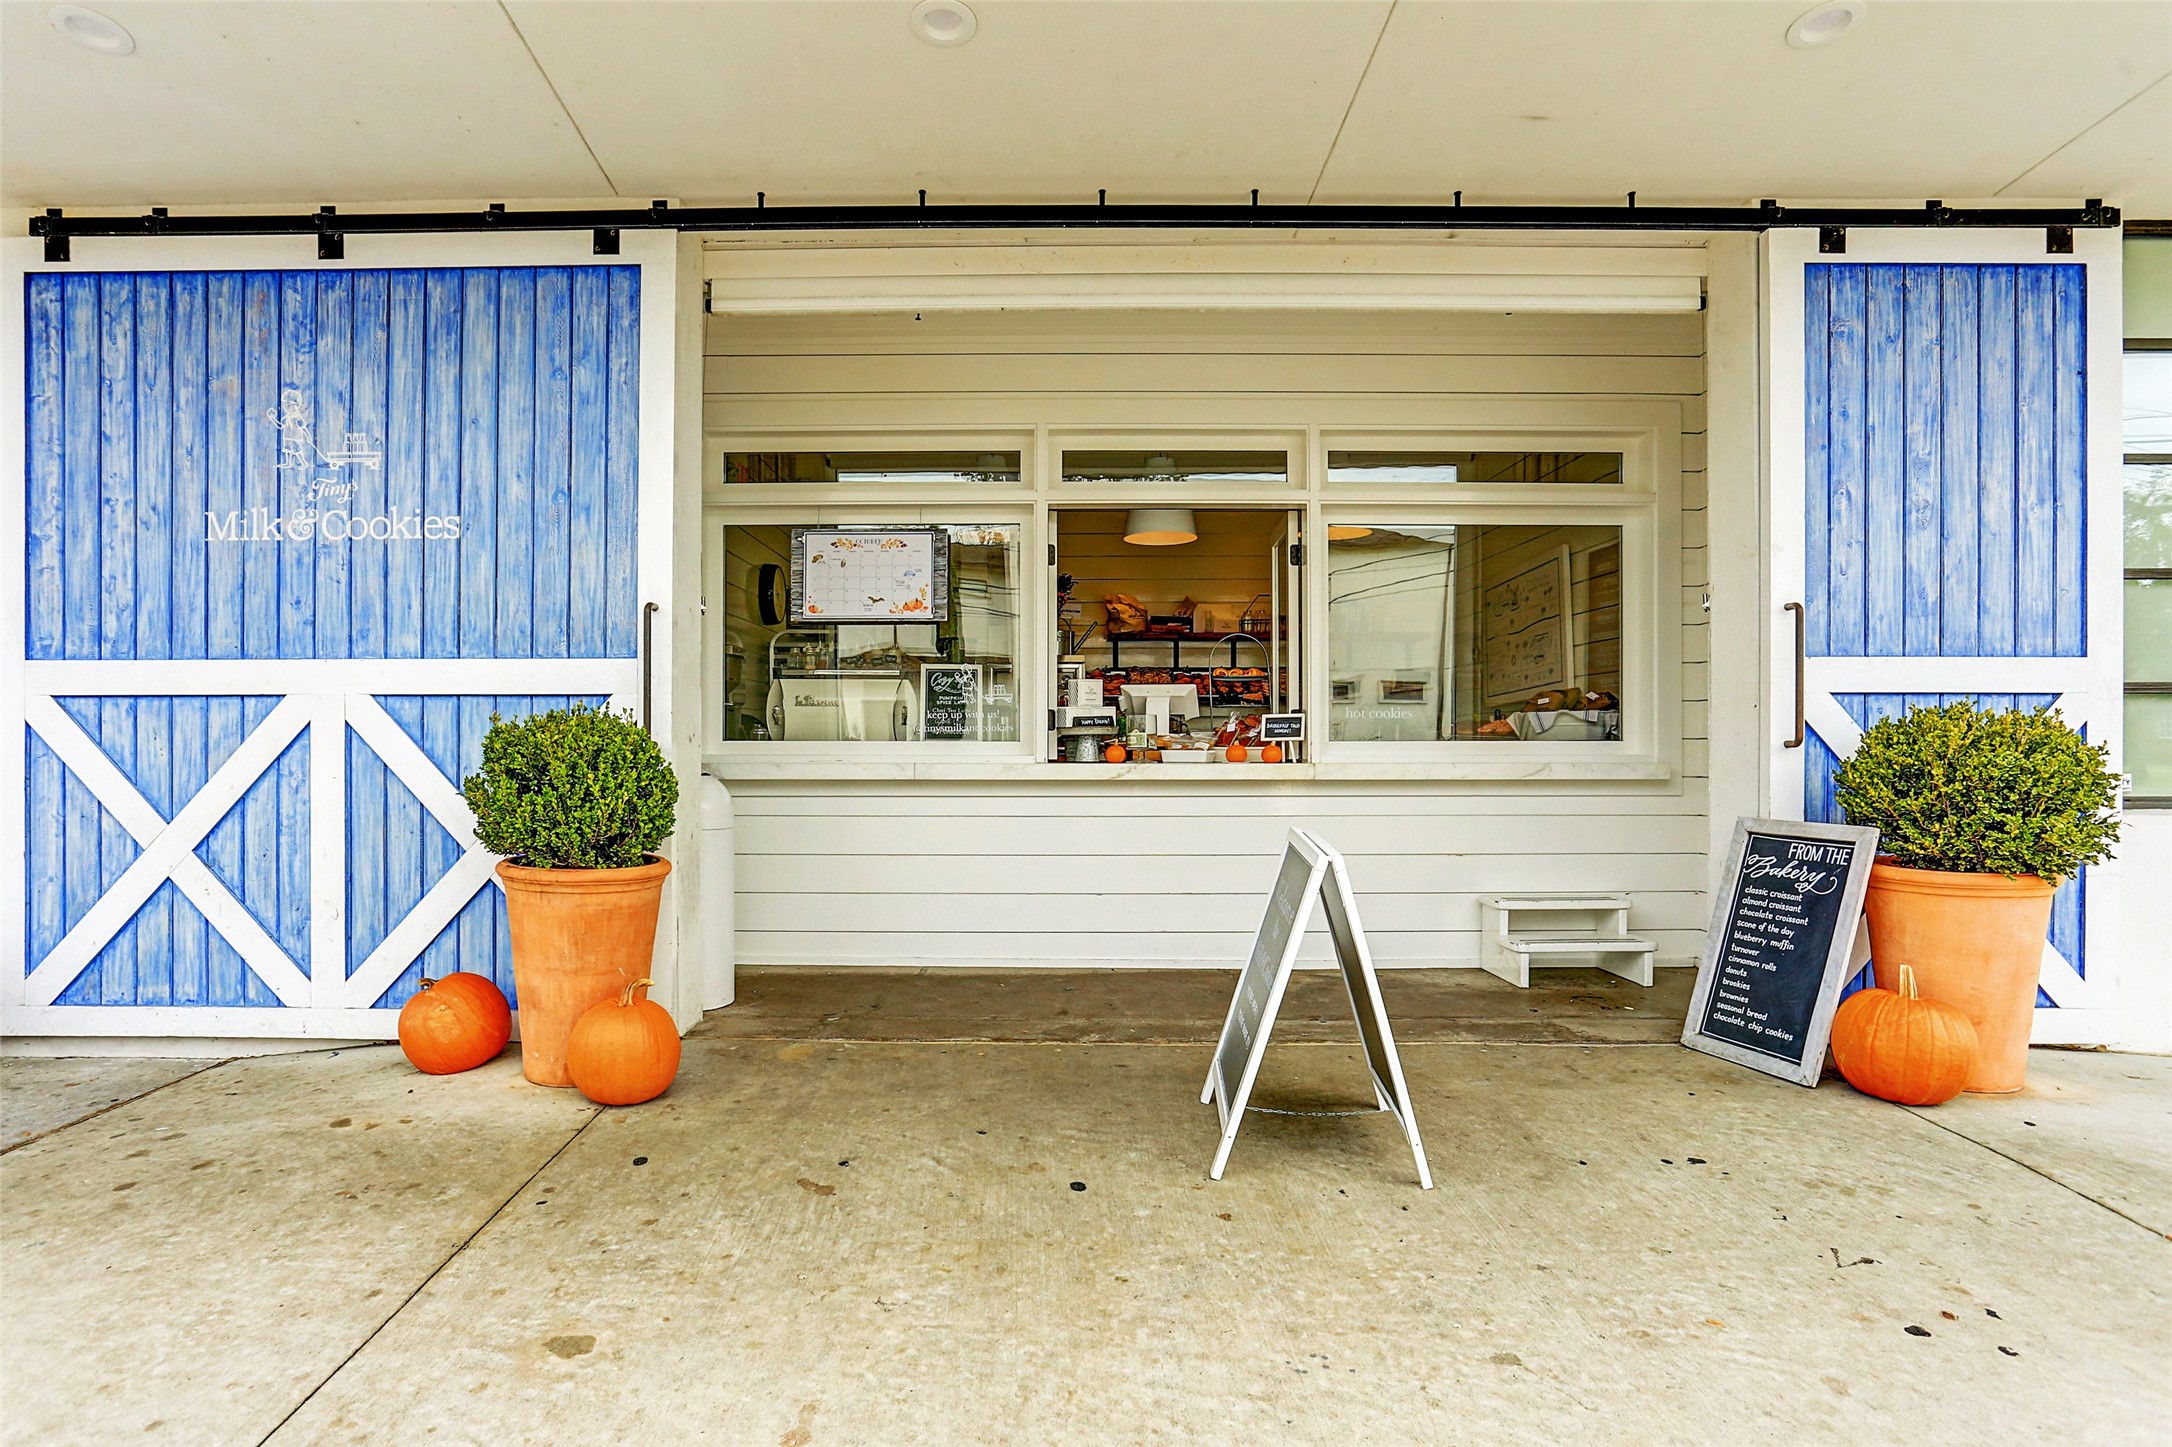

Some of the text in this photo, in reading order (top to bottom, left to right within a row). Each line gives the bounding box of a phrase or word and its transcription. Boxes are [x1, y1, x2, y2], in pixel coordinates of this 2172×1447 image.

[307, 477, 358, 504] Tiny's
[205, 506, 461, 541] Milk & Cookies
[927, 710, 948, 722] keep
[950, 712, 963, 721] up
[965, 709, 984, 718] with
[987, 709, 1000, 718] us!
[1346, 706, 1413, 719] hot cookies
[1788, 843, 1851, 866] FROM THE
[1743, 854, 1838, 895] Bakery
[1744, 884, 1803, 902] classic croissant
[1742, 896, 1802, 913] almond croissant
[1739, 906, 1809, 926] chocolate croissant
[1736, 920, 1795, 939] scone of the day
[1731, 943, 1760, 956] turnover
[1734, 930, 1795, 951] blueberry muffin
[1725, 966, 1748, 977] donuts
[1728, 954, 1777, 972] cinnamon rolls
[1722, 977, 1751, 990] brookies
[1719, 989, 1749, 1003] brownies
[1716, 1002, 1768, 1020] seasonal bread
[1713, 1011, 1794, 1041] chocolate chip cookies
